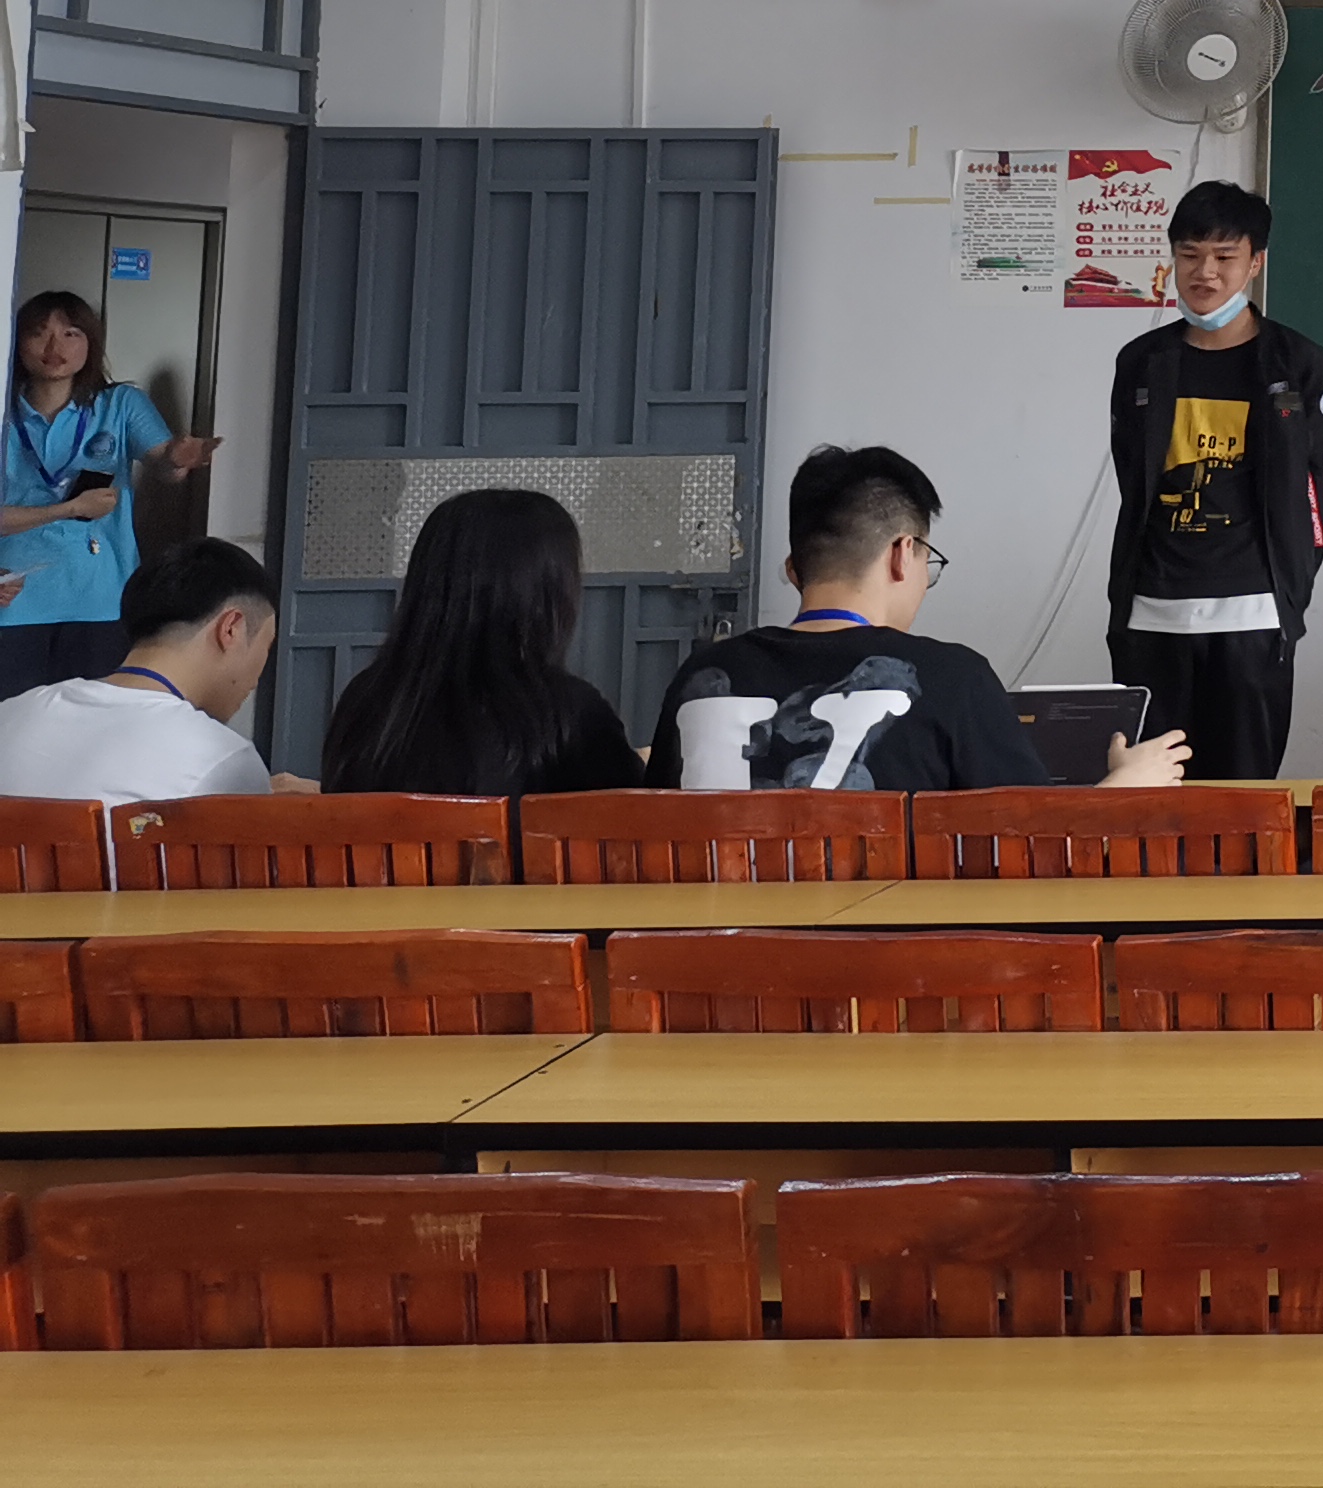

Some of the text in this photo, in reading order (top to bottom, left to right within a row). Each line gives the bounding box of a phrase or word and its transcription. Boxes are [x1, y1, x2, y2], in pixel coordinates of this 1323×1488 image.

[1100, 180, 1155, 199] 社会主义
[1078, 198, 1169, 218] 核心价值观
